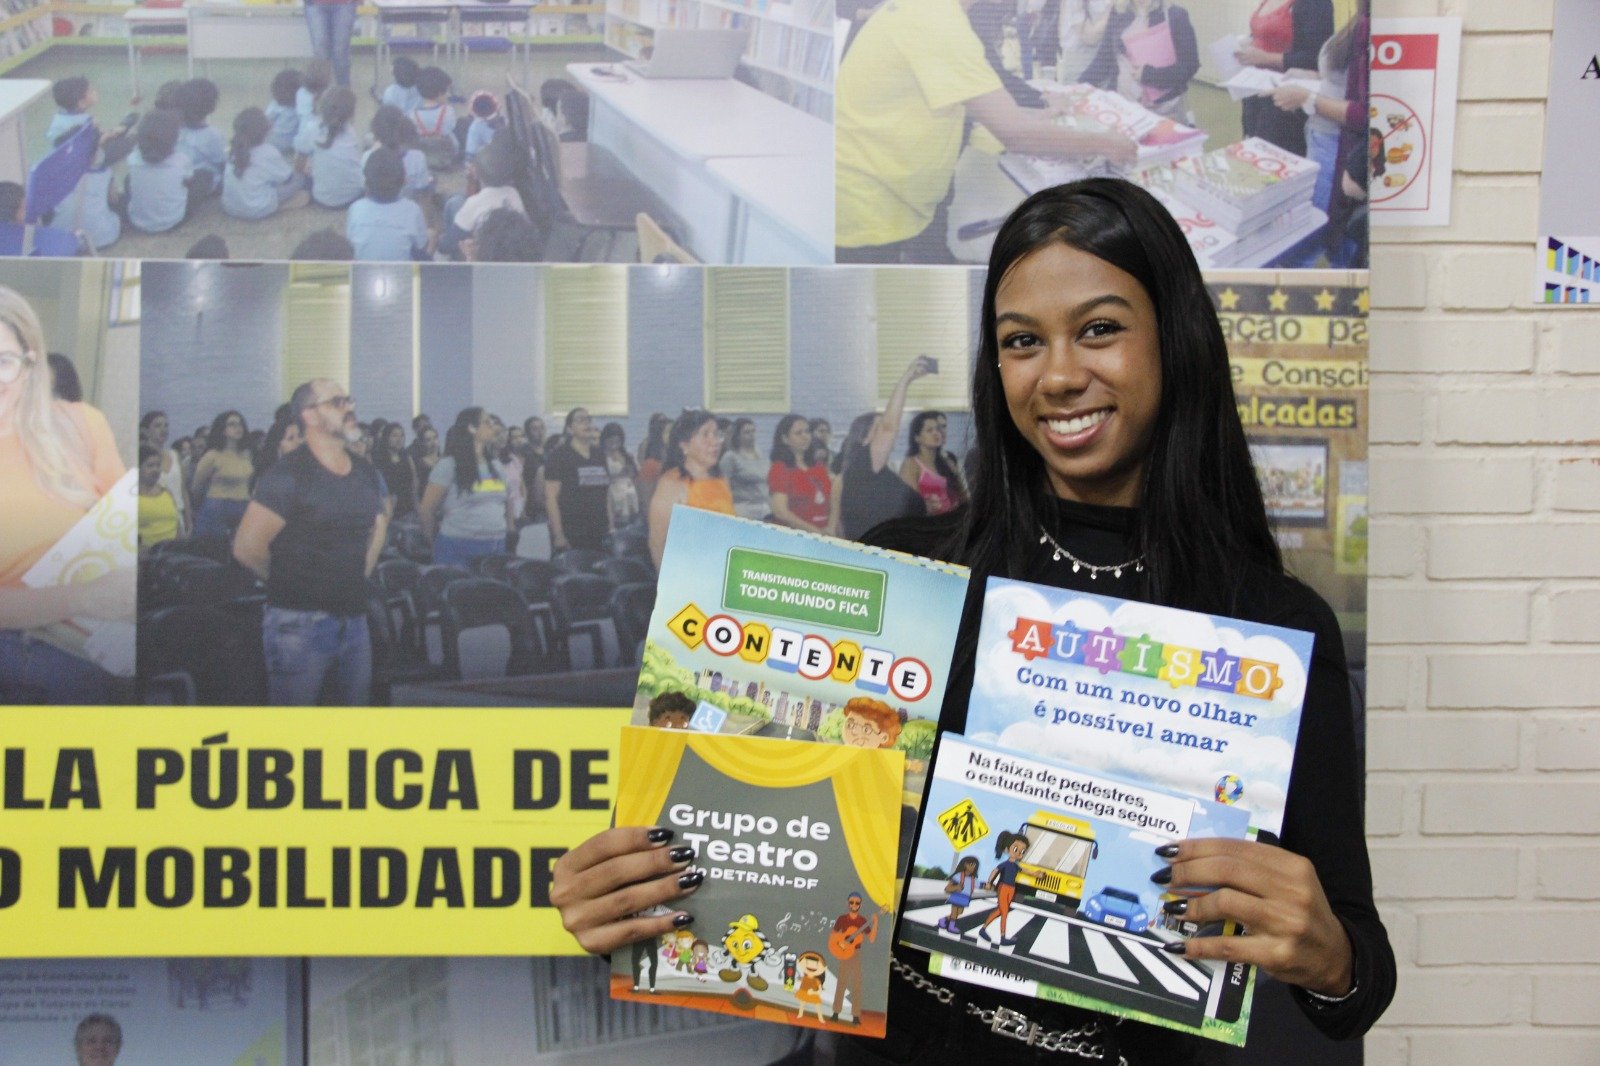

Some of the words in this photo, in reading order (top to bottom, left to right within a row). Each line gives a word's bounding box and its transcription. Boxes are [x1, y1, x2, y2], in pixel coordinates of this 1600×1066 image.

[1370, 41, 1402, 65] O
[740, 584, 778, 601] TODO
[782, 592, 835, 612] MUNDO
[838, 601, 869, 617] FICA
[742, 569, 809, 588] TRANSITANDO
[811, 581, 870, 600] CONSCIENTE
[682, 619, 916, 689] CONTENTE
[1017, 624, 1274, 695] AUTISMO
[1016, 667, 1068, 692] Com
[1075, 683, 1113, 701] um
[1120, 692, 1181, 714] novo
[1189, 700, 1257, 728] olhar
[1033, 699, 1047, 717] é
[1053, 707, 1153, 739] possível
[1160, 728, 1229, 753] amar
[4, 748, 102, 810] LA
[136, 731, 480, 810] PÚBLICA
[513, 750, 611, 810] DE
[969, 752, 992, 769] Na
[993, 757, 1033, 779] faixa
[1036, 769, 1057, 786] de
[1060, 775, 1148, 810] pedestres,
[669, 804, 778, 836] Grupo
[786, 816, 831, 841] de
[965, 770, 975, 781] o
[978, 772, 1061, 802] estudante
[1063, 791, 1115, 818] chega
[1118, 808, 1180, 834] seguro.
[683, 832, 818, 871] Teatro
[711, 867, 819, 890] DETRAN-DF
